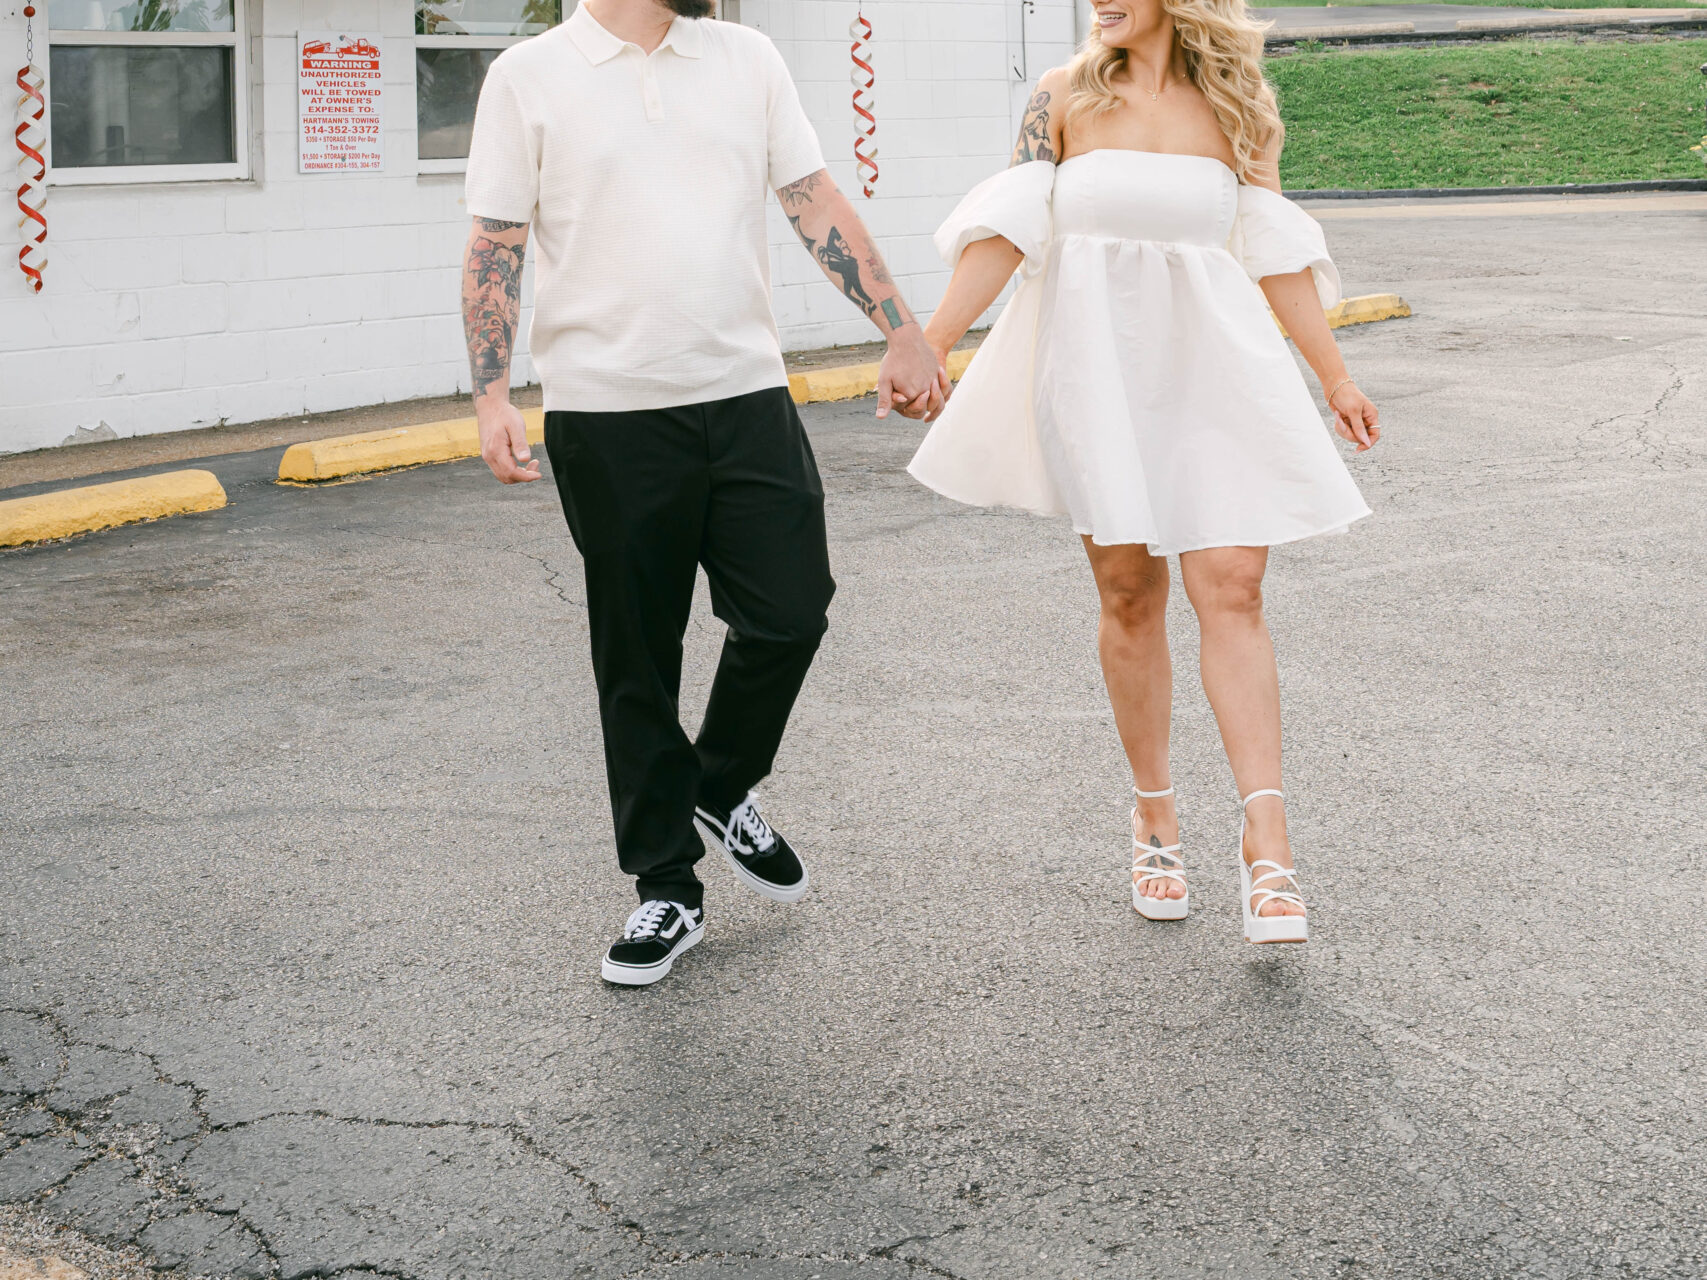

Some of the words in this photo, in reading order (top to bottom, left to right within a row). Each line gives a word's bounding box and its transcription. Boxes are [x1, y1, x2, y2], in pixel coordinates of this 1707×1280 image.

[310, 60, 371, 69] WARNING
[301, 71, 381, 79] UNAUTHORIZED
[304, 125, 379, 134] 314-352-3372
